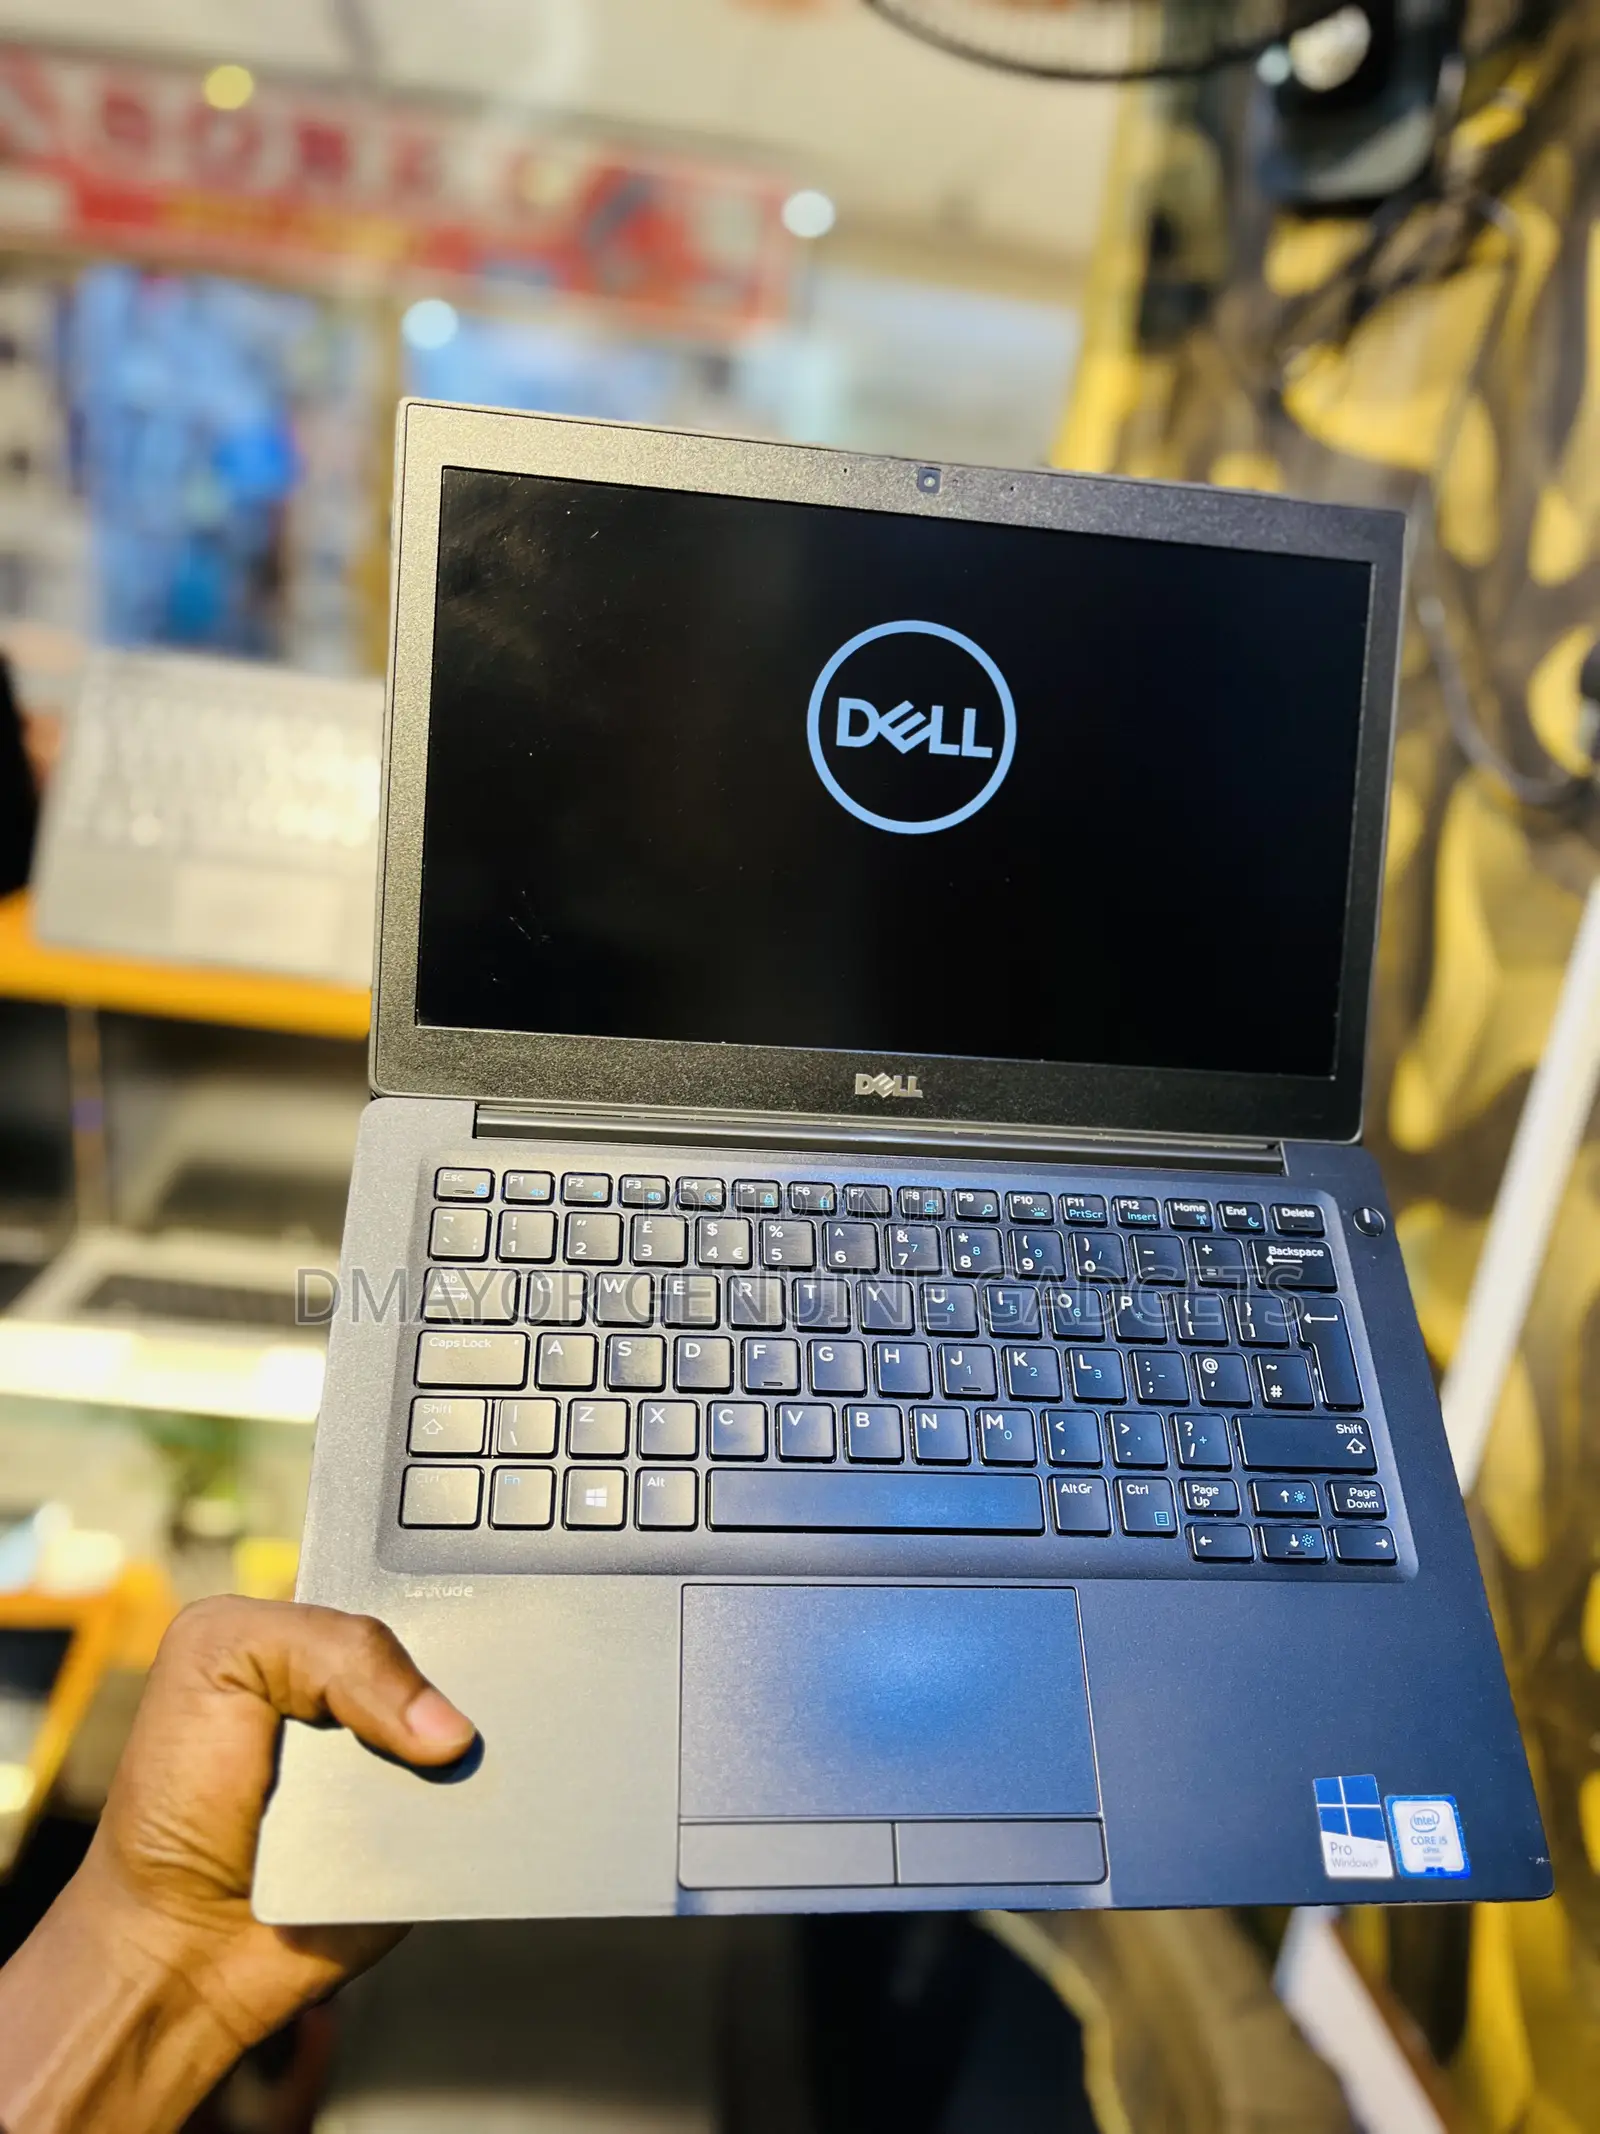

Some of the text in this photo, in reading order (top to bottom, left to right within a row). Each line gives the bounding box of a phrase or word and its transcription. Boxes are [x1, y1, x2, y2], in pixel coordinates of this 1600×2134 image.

[836, 697, 993, 758] DELL
[855, 1073, 923, 1098] DELL
[443, 1173, 465, 1182] Esc
[510, 1175, 524, 1184] F1
[568, 1178, 584, 1188] F2
[626, 1179, 642, 1189] F3
[683, 1181, 698, 1191] F4
[740, 1183, 755, 1193] F5
[795, 1186, 810, 1196] F6
[851, 1188, 865, 1198] F7
[905, 1191, 920, 1201] F8
[959, 1193, 974, 1203] F9
[1013, 1195, 1033, 1205] F10
[1067, 1198, 1085, 1208] F11
[1120, 1200, 1140, 1210] F12
[1174, 1203, 1206, 1213] Home
[1226, 1206, 1247, 1216] End
[1069, 1209, 1103, 1219] PrtScr
[1127, 1211, 1157, 1222] Insert
[1282, 1208, 1315, 1219] Delete
[642, 1222, 653, 1233] £
[707, 1222, 718, 1237] $
[769, 1225, 783, 1238] %
[897, 1230, 909, 1243] &
[508, 1241, 516, 1253] 1
[575, 1243, 587, 1255] 2
[641, 1244, 653, 1257] 3
[707, 1247, 719, 1259] 4
[732, 1247, 744, 1259] €
[972, 1246, 981, 1256] 8
[1034, 1248, 1043, 1258] 9
[1268, 1246, 1324, 1258] Backspace
[771, 1248, 783, 1261] 5
[835, 1250, 846, 1263] 6
[899, 1253, 909, 1265] 7
[960, 1255, 972, 1268] 8
[1023, 1257, 1034, 1271] 9
[1084, 1261, 1096, 1273] 0
[603, 1279, 625, 1294] W
[673, 1280, 686, 1295] E
[739, 1282, 752, 1297] R
[803, 1285, 817, 1299] T
[868, 1287, 883, 1301] Y
[930, 1288, 945, 1303] U
[1057, 1293, 1072, 1308] O
[1121, 1297, 1133, 1310] P
[947, 1303, 955, 1313] 4
[1009, 1305, 1017, 1315] 5
[1073, 1307, 1081, 1317] 6
[429, 1337, 492, 1350] Caps Lock
[548, 1340, 564, 1355] A
[618, 1341, 632, 1357] S
[685, 1344, 701, 1358] D
[753, 1345, 766, 1359] F
[819, 1347, 834, 1362] G
[885, 1349, 900, 1364] H
[951, 1351, 964, 1365] J
[1014, 1352, 1028, 1367] K
[1079, 1355, 1092, 1369] L
[1030, 1367, 1038, 1377] 2
[1203, 1358, 1219, 1374] @
[1095, 1369, 1102, 1379] 3
[1270, 1385, 1282, 1397] #
[422, 1404, 452, 1414] Shift
[579, 1407, 595, 1422] Z
[650, 1408, 665, 1423] X
[719, 1409, 734, 1424] C
[787, 1410, 803, 1425] V
[856, 1413, 870, 1427] B
[921, 1414, 937, 1429] N
[986, 1414, 1004, 1430] M
[1184, 1422, 1194, 1436] ?
[1336, 1424, 1363, 1434] Shift
[504, 1476, 521, 1485] Fn
[647, 1477, 665, 1487] Alt
[1127, 1484, 1149, 1495] Ctrl
[1192, 1486, 1219, 1497] Page
[1350, 1488, 1376, 1499] Page
[1194, 1497, 1210, 1507] Up
[1347, 1499, 1379, 1510] Down
[1411, 1836, 1436, 1845] CORE
[1330, 1841, 1352, 1855] Pro
